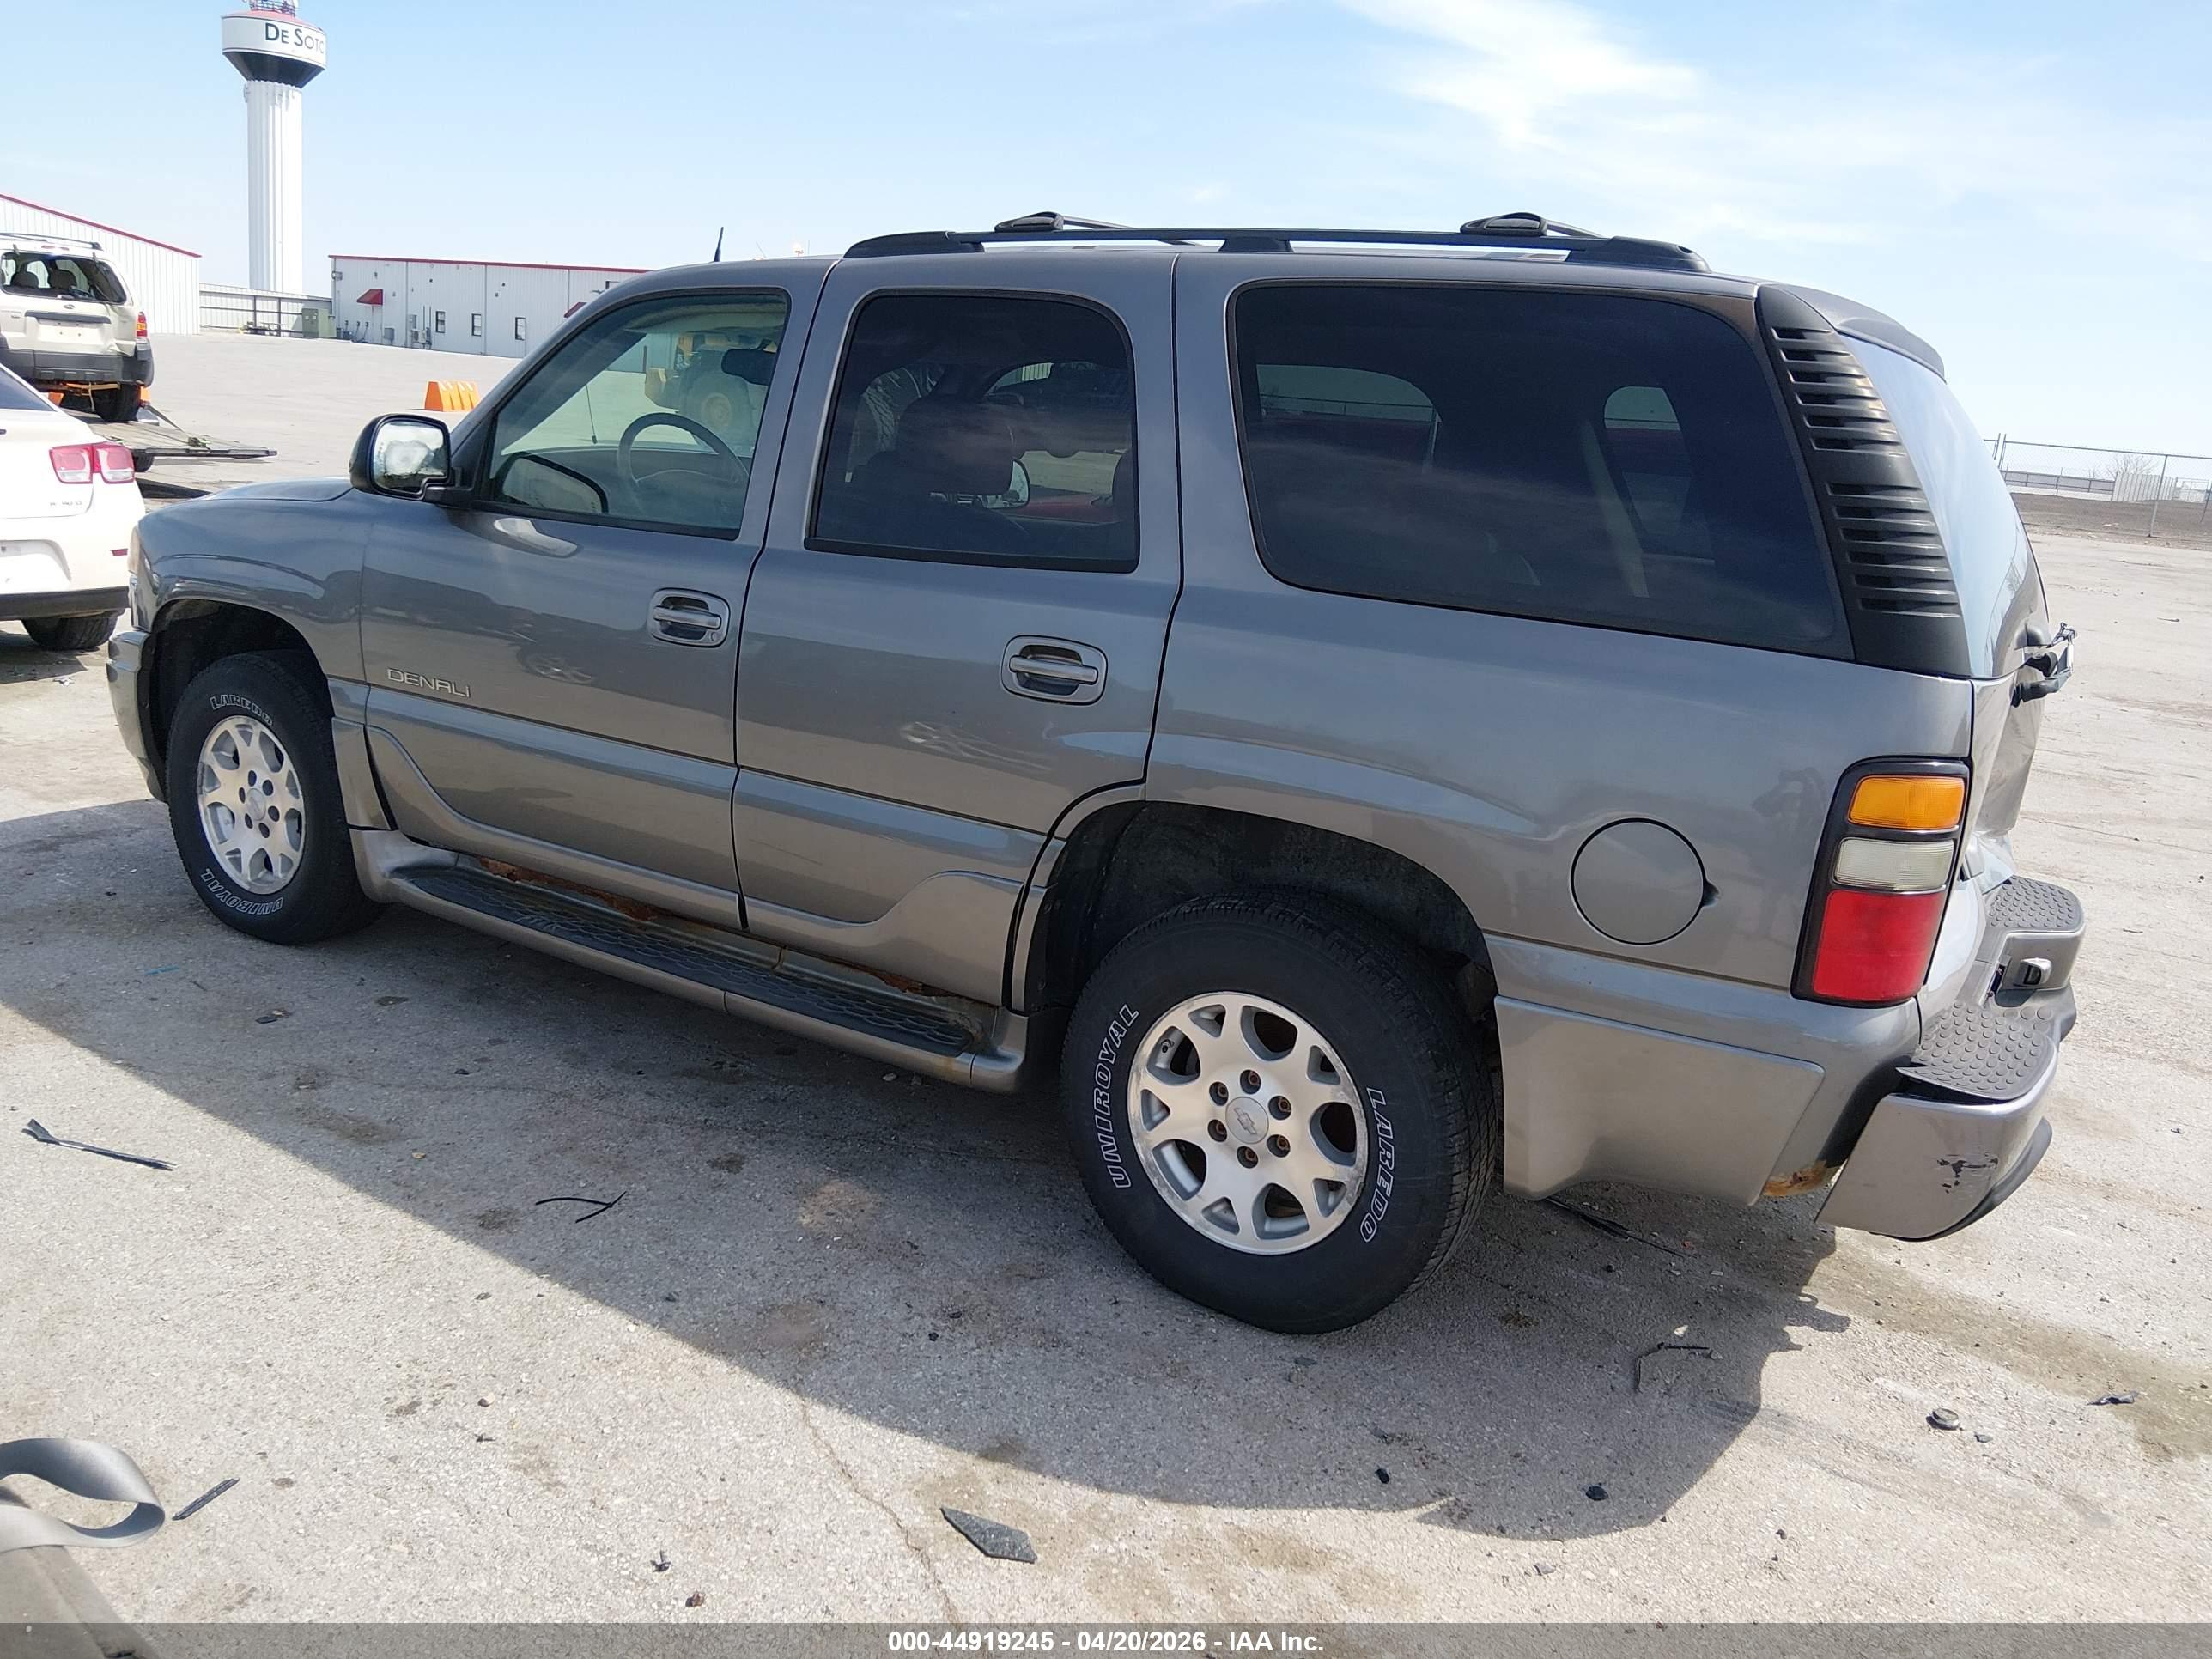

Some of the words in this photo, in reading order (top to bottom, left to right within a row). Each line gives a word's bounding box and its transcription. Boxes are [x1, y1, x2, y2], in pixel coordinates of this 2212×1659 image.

[386, 667, 471, 698] DENALI
[209, 694, 273, 726] LAREDO
[200, 867, 283, 915] UNIROYAL
[1092, 1004, 1139, 1189] UNIROYAL
[1359, 1086, 1395, 1243] LAREDO
